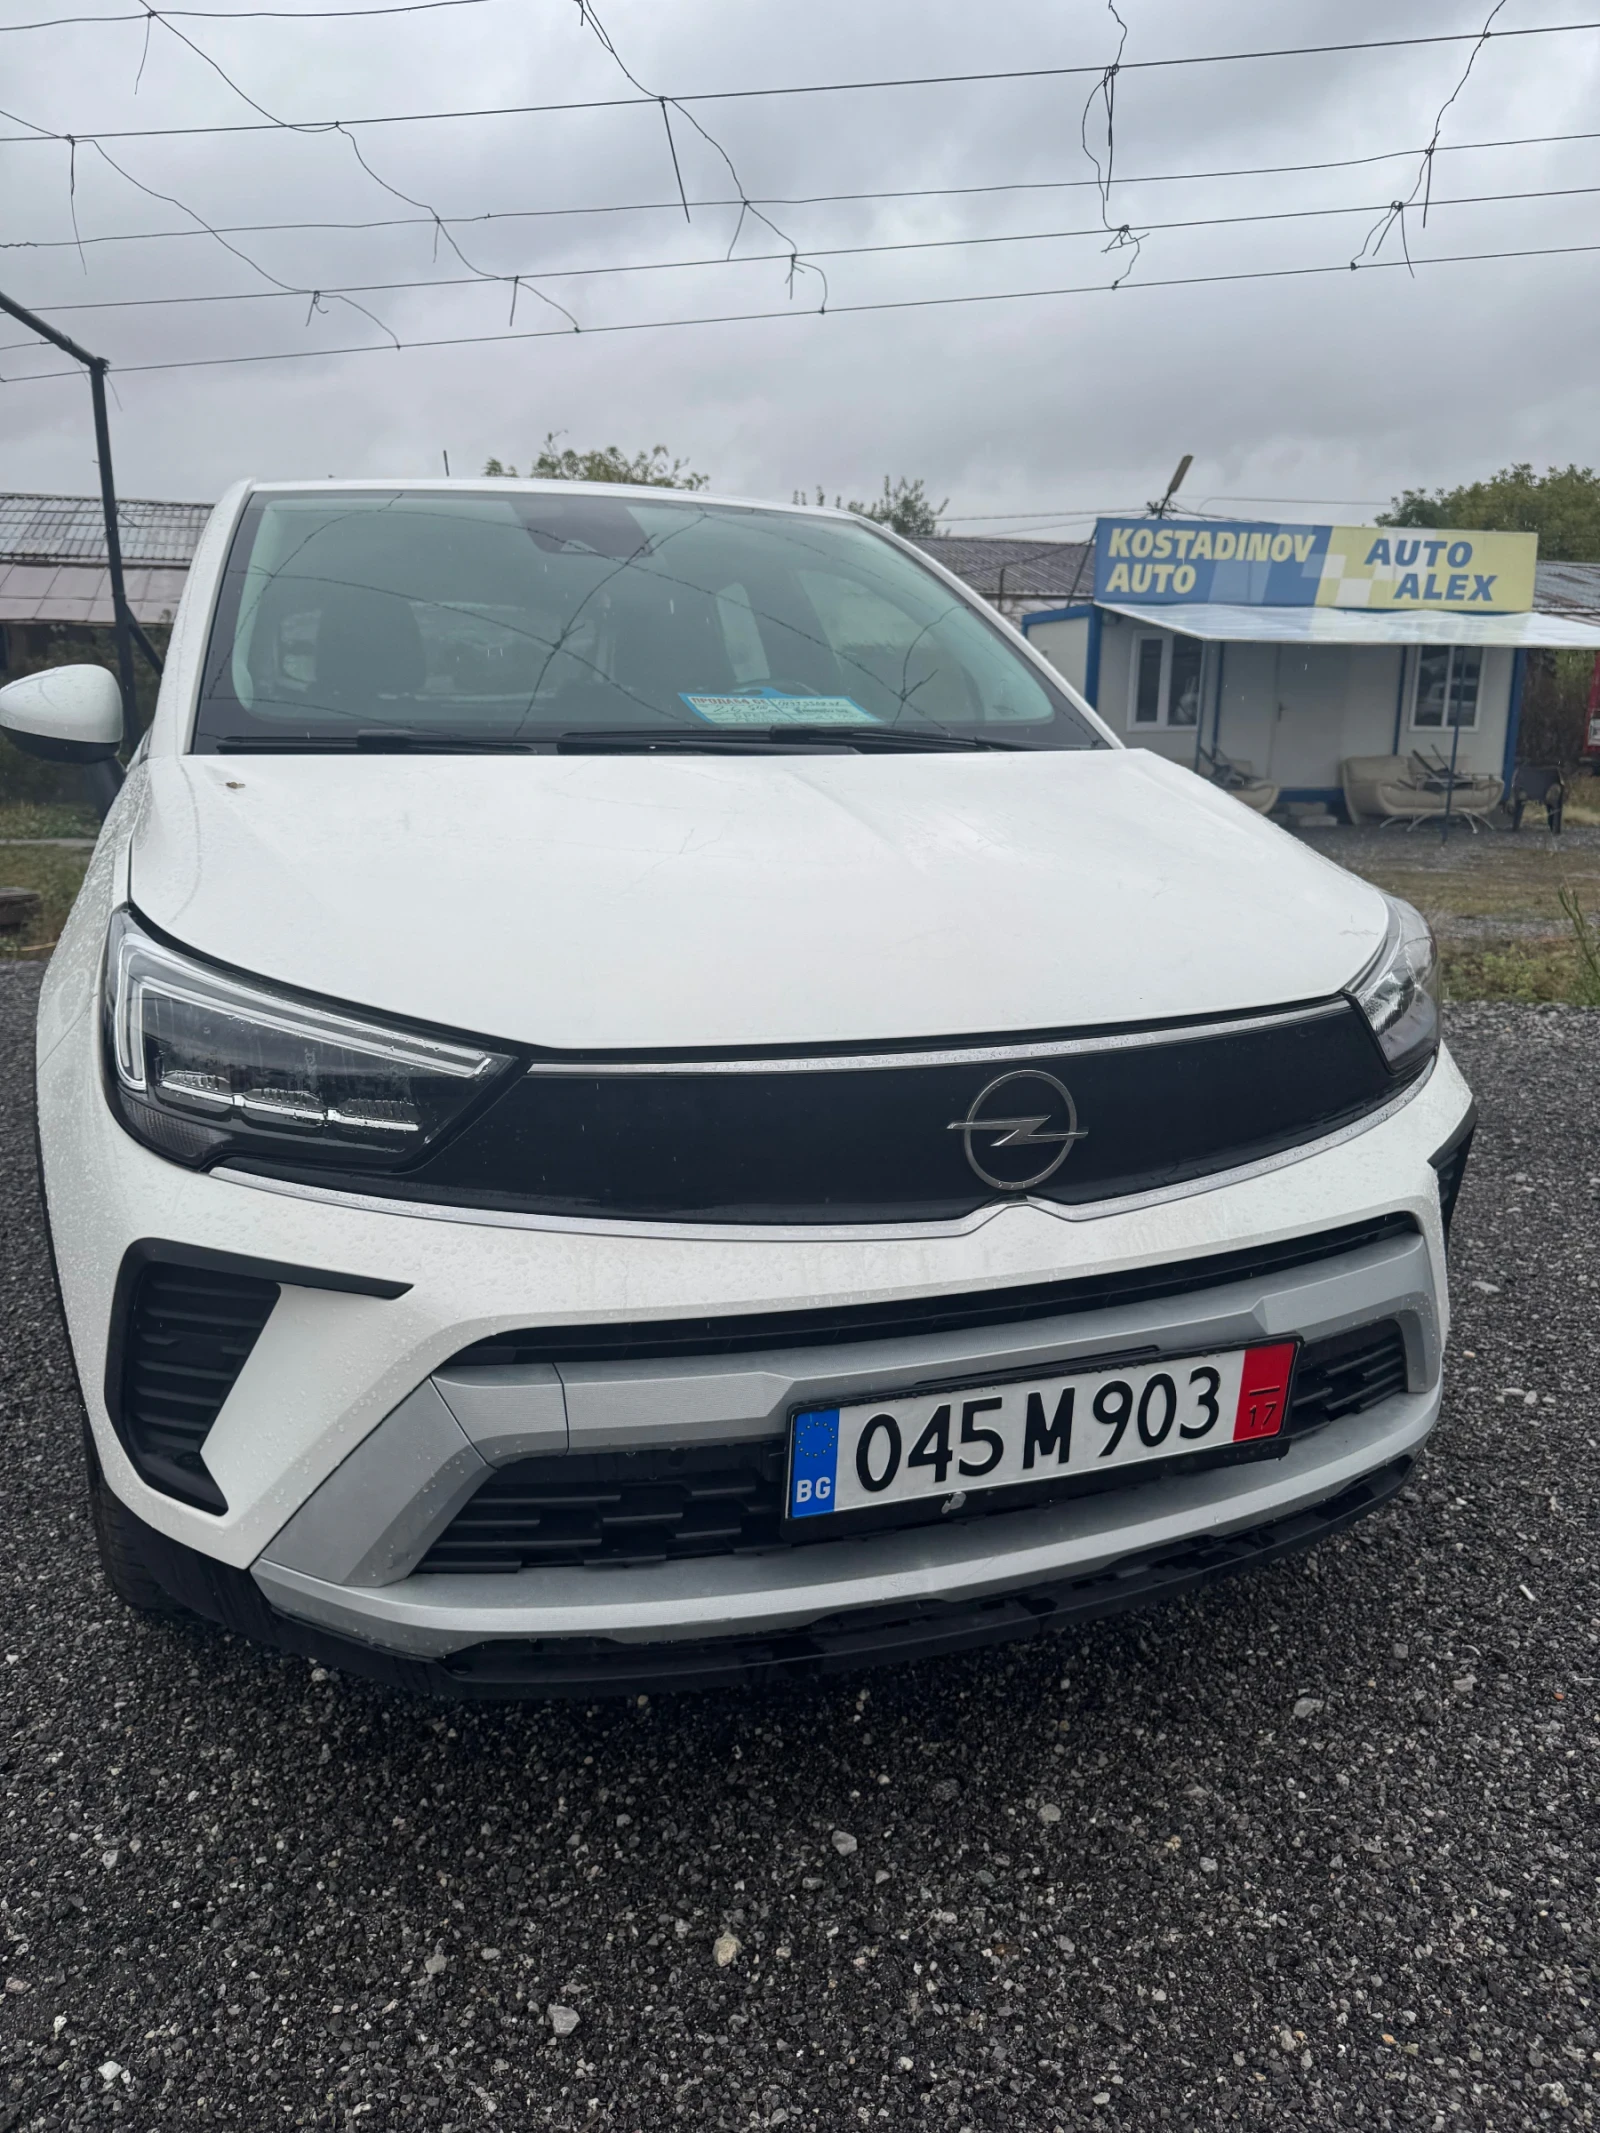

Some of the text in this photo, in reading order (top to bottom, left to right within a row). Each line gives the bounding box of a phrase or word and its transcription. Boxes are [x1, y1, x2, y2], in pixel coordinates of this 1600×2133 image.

[1108, 528, 1316, 563] KOSTADINOV
[1364, 538, 1473, 568] AUTO
[1105, 563, 1196, 594] AUTO
[1393, 573, 1497, 601] ALEX
[856, 1366, 1221, 1493] 045 M 903
[1249, 1401, 1277, 1430] 17
[796, 1475, 832, 1503] BG
